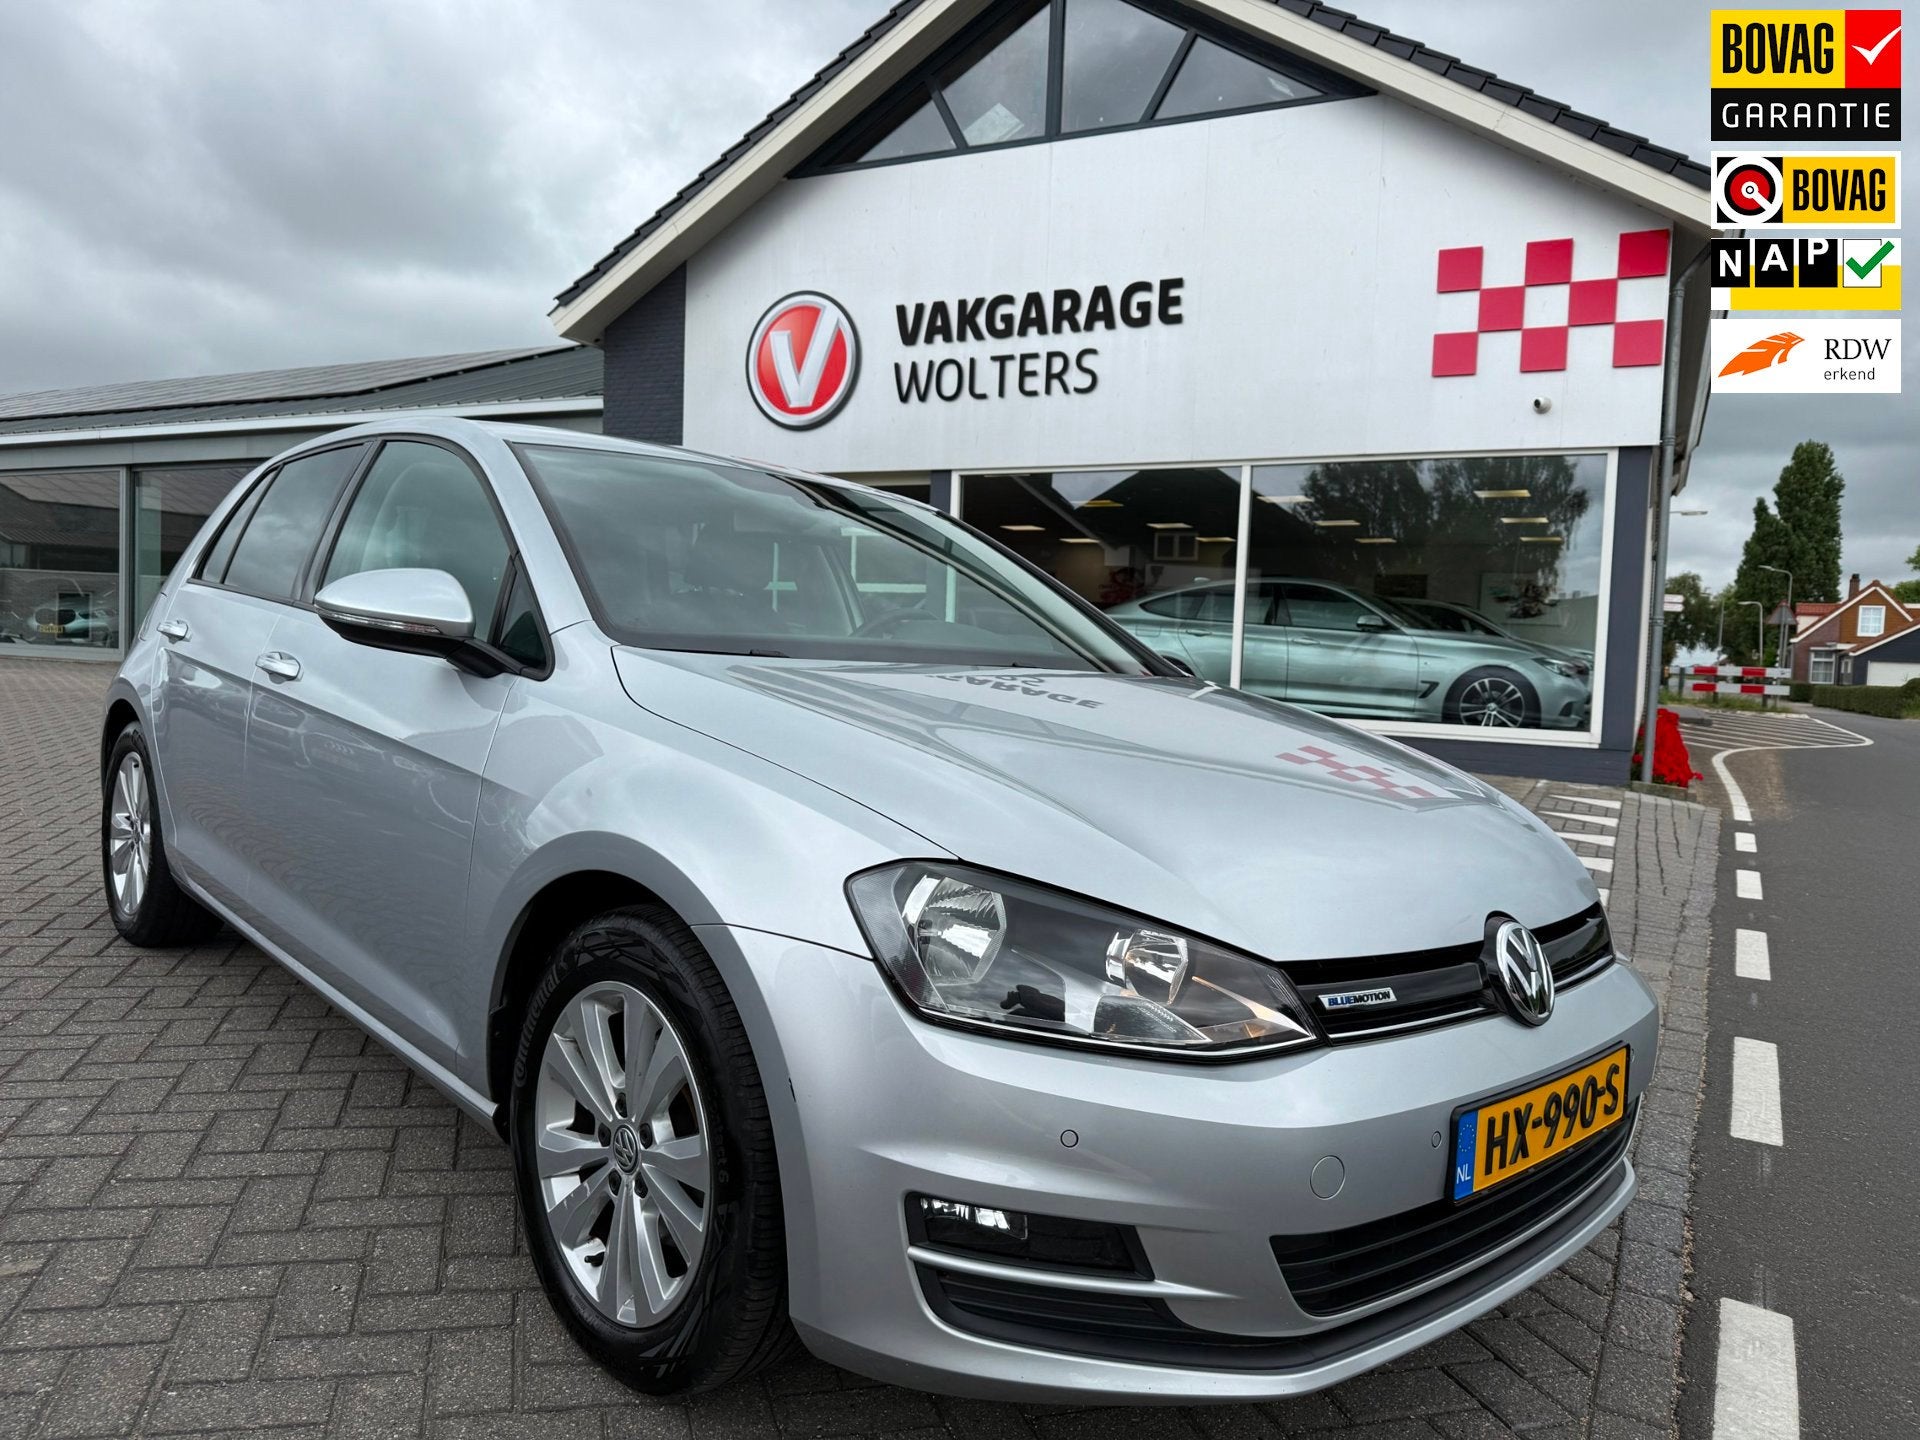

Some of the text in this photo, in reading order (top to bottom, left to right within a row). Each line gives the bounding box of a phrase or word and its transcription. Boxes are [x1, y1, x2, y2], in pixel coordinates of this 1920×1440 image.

[895, 277, 1184, 345] VAKGARAGE
[893, 348, 1099, 403] WOLTERS
[513, 963, 561, 1088] Continental
[1327, 991, 1390, 1006] BLUEMOTION
[1484, 1063, 1620, 1176] HX-990-S
[1456, 1165, 1471, 1185] NL
